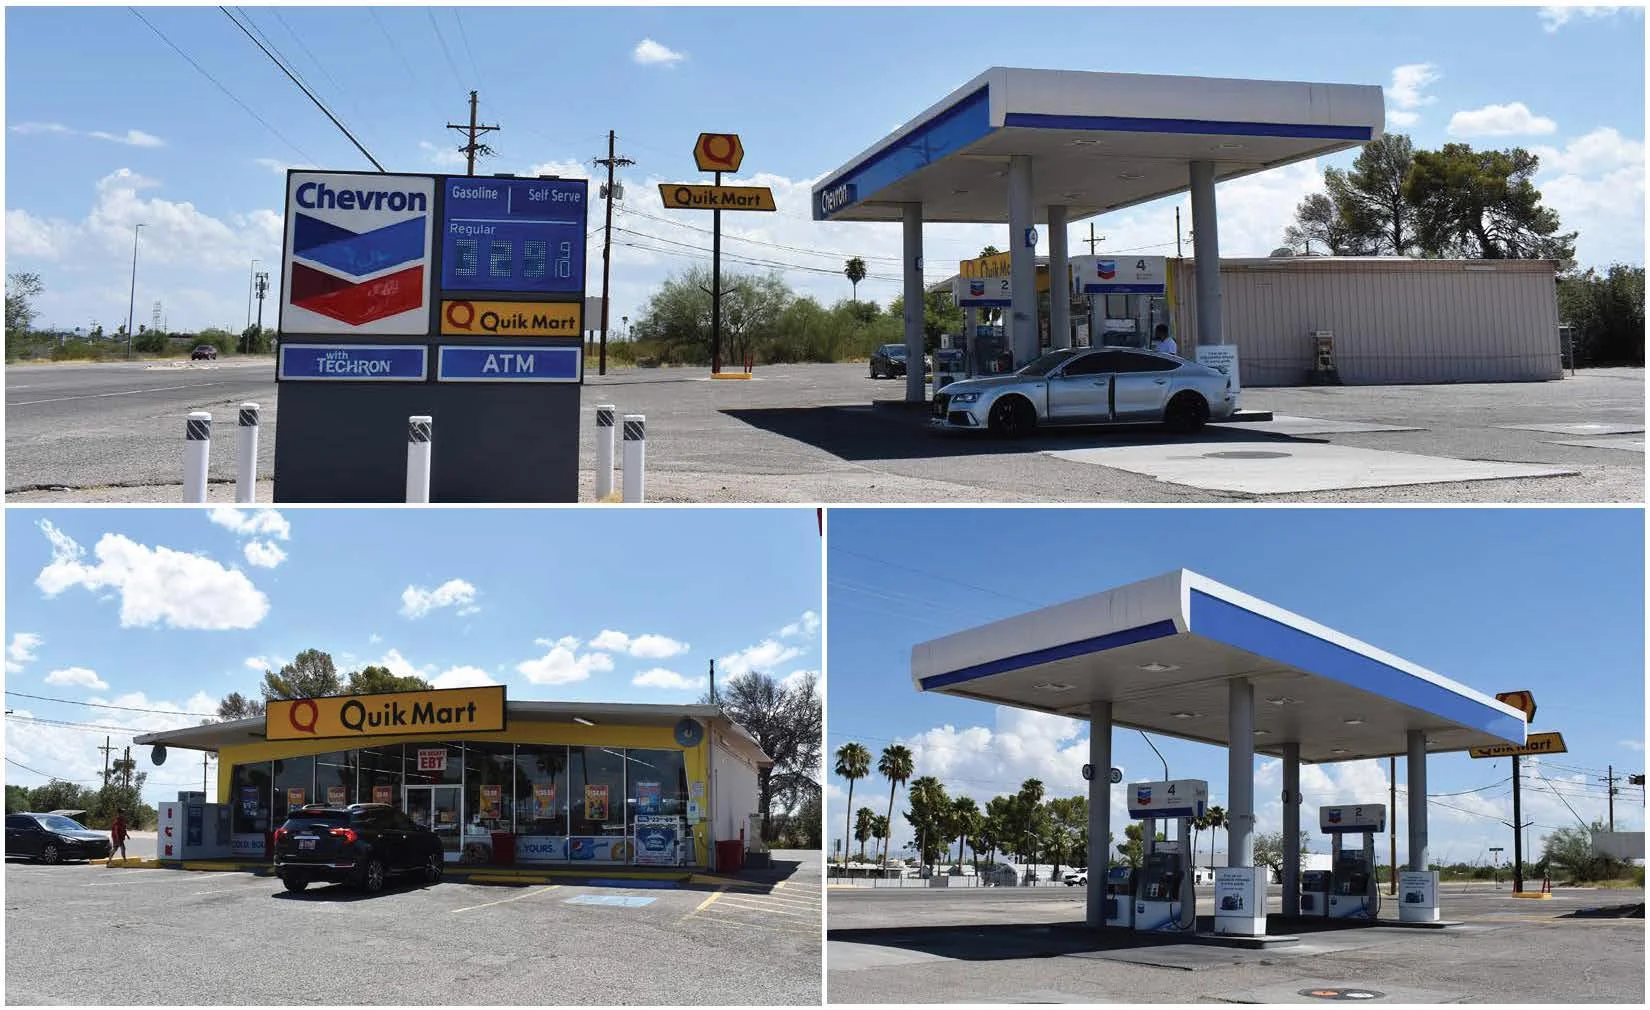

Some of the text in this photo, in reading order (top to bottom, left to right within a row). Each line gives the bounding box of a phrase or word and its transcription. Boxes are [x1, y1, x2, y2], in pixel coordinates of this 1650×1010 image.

[296, 182, 427, 212] Chevron
[452, 185, 581, 203] Gasoline Self Serve
[675, 187, 761, 206] Quik Mart
[821, 183, 847, 213] Chevron
[450, 223, 496, 236] Regular
[1136, 259, 1146, 271] 4
[1001, 280, 1009, 289] 2
[446, 301, 576, 333] Q Quik Mart
[326, 350, 349, 360] with
[482, 353, 535, 374] ATM
[317, 358, 391, 376] TECHRON
[289, 698, 477, 735] Q Quik Mart
[421, 756, 443, 769] EBT
[1167, 784, 1176, 795] 4
[1355, 807, 1363, 816] 2
